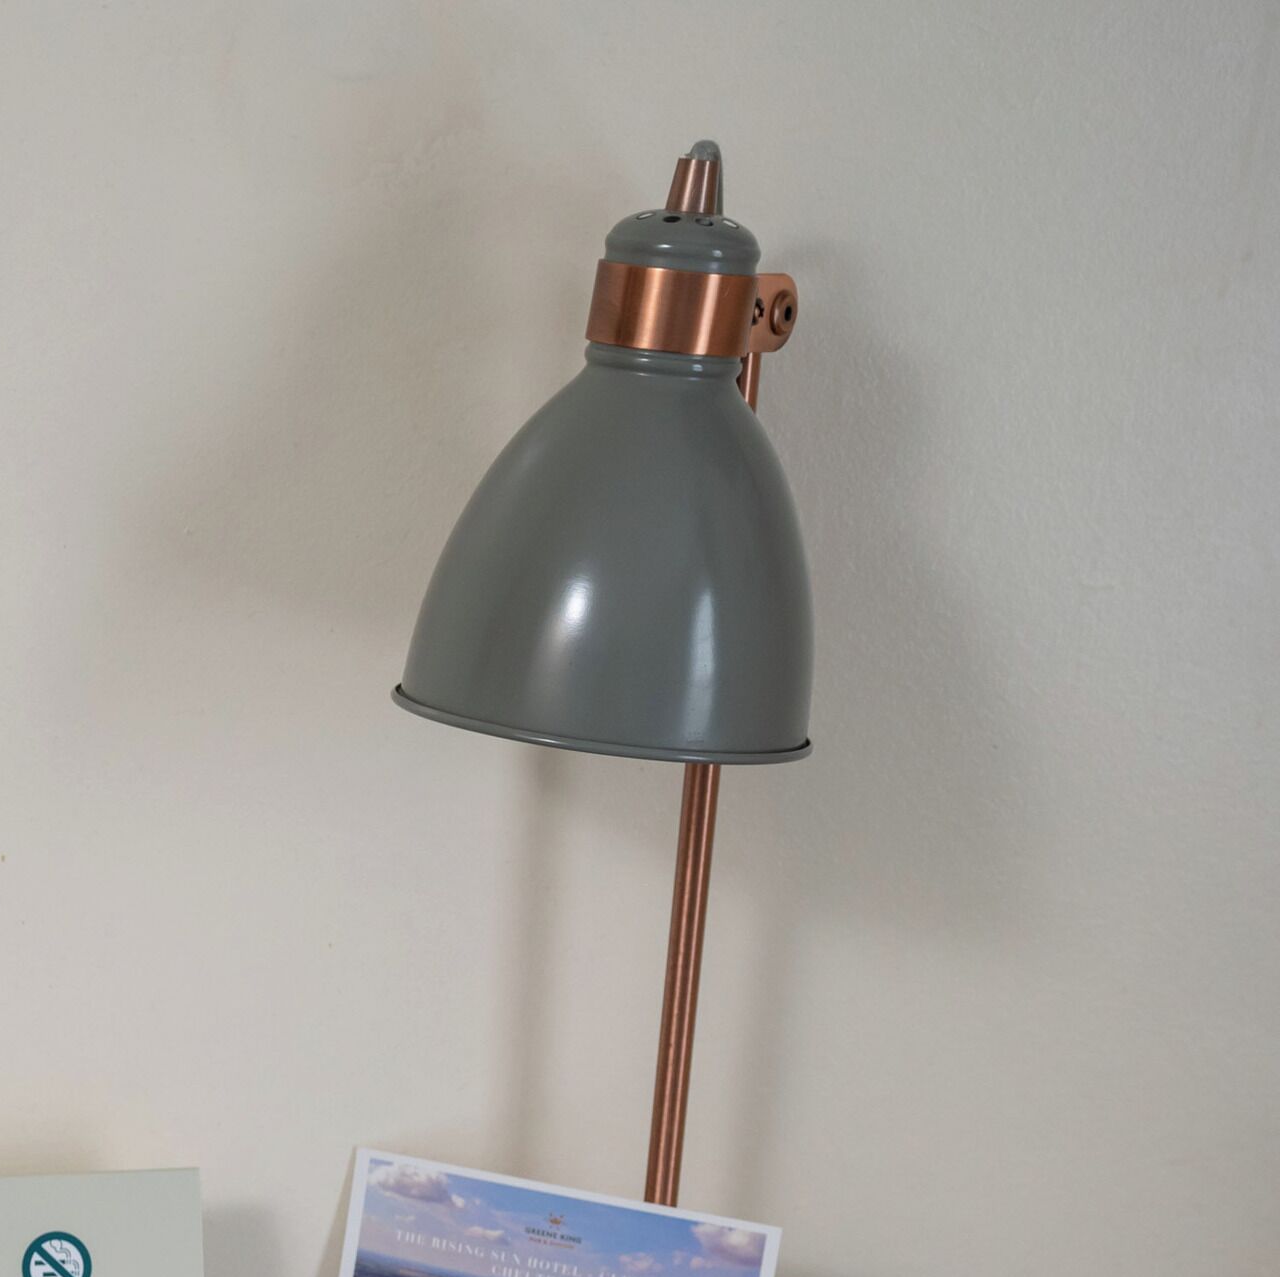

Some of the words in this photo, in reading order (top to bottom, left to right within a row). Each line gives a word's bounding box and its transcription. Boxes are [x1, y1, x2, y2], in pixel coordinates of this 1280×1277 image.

[395, 1230, 425, 1246] THE
[431, 1237, 485, 1259] RISING
[491, 1250, 520, 1266] SUN
[527, 1256, 582, 1277] HOTEL
